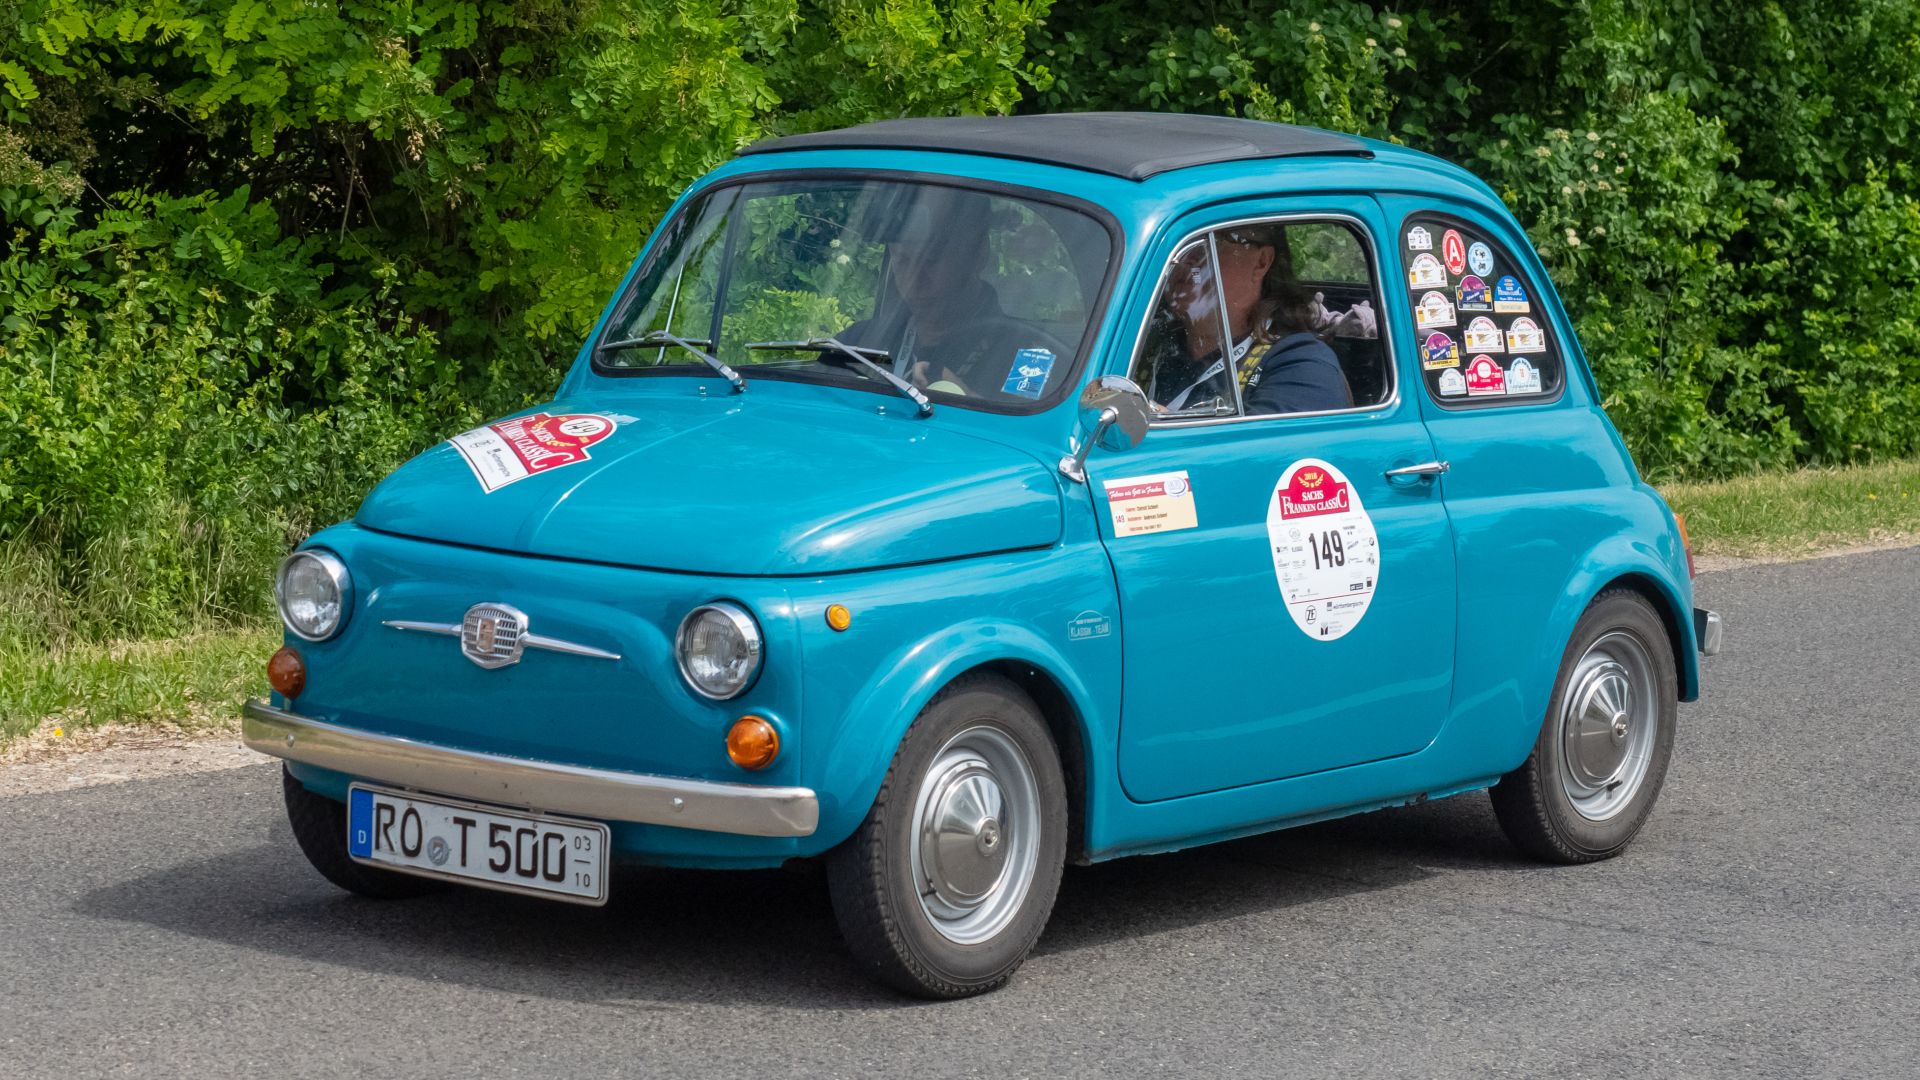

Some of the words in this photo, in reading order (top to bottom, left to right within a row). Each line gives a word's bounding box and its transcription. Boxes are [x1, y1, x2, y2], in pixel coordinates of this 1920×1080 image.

[1450, 239, 1461, 262] A
[1281, 495, 1317, 516] FRANKEN
[1316, 488, 1348, 512] CLASSIC
[1302, 489, 1325, 502] SACHS
[1309, 530, 1345, 570] 149
[358, 830, 366, 844] D
[375, 803, 423, 858] RO
[453, 816, 477, 867] T
[489, 822, 566, 882] 500
[574, 835, 592, 852] 03
[575, 872, 591, 888] 10
